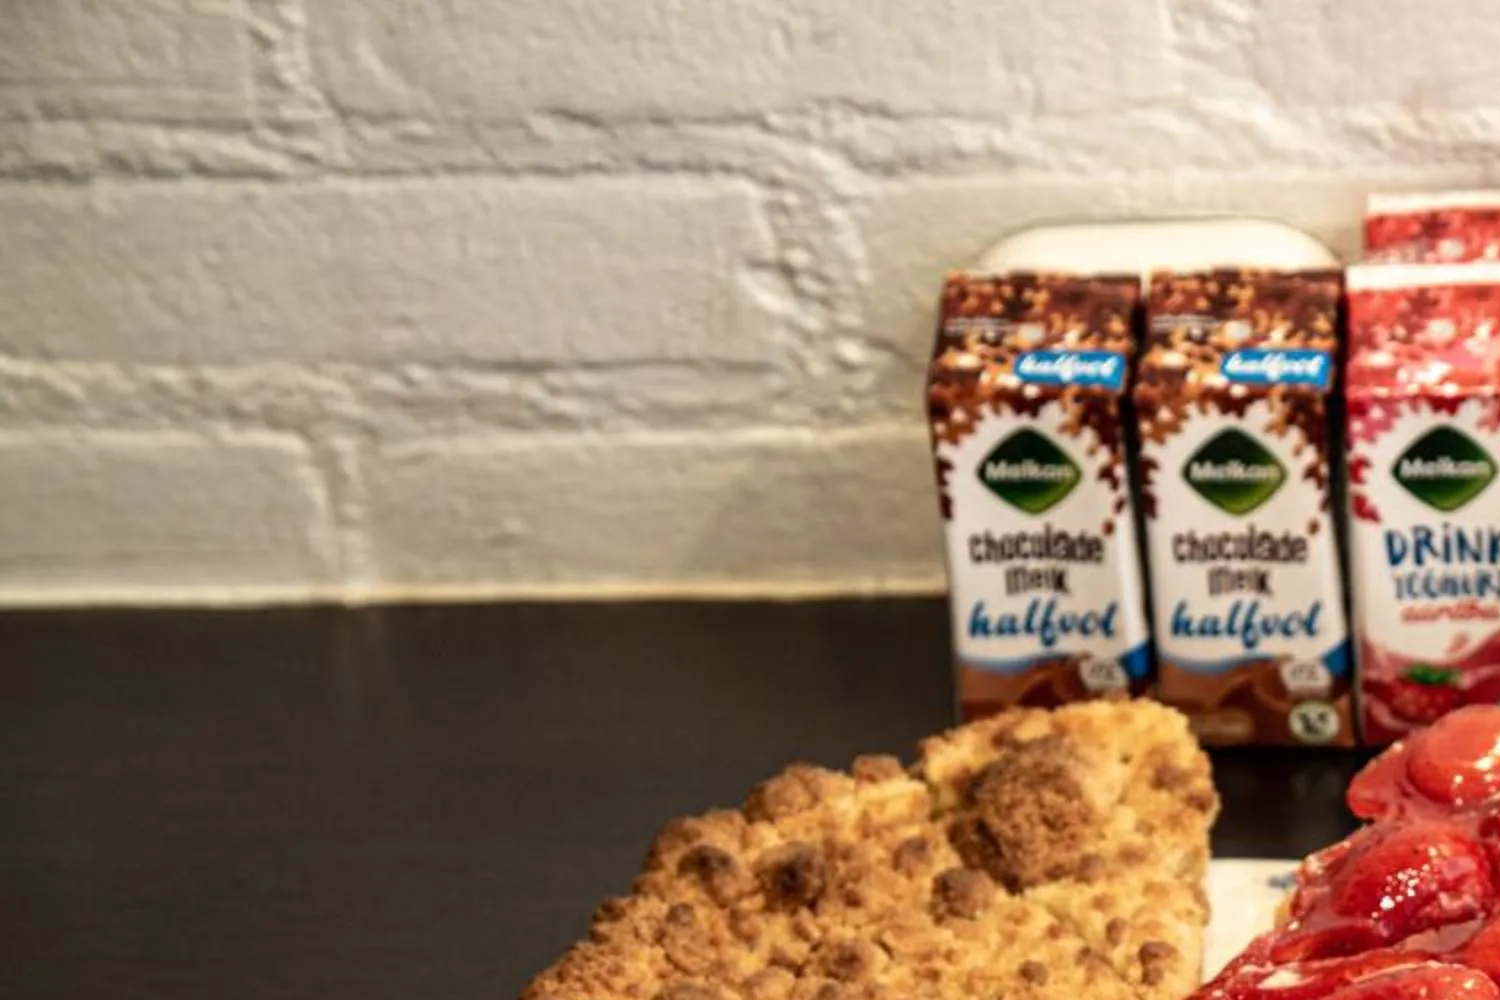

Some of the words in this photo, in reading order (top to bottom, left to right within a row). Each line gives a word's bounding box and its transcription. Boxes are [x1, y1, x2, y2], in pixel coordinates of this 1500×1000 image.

[985, 460, 1075, 482] Melkan
[1190, 460, 1281, 482] Melkan
[1401, 456, 1492, 479] Melkan
[968, 522, 1103, 563] chocolade
[1172, 522, 1308, 563] chocolade
[1005, 567, 1070, 596] melk
[1208, 567, 1272, 596] melk
[968, 599, 1119, 647] halfvol
[1170, 599, 1323, 649] halfvol
